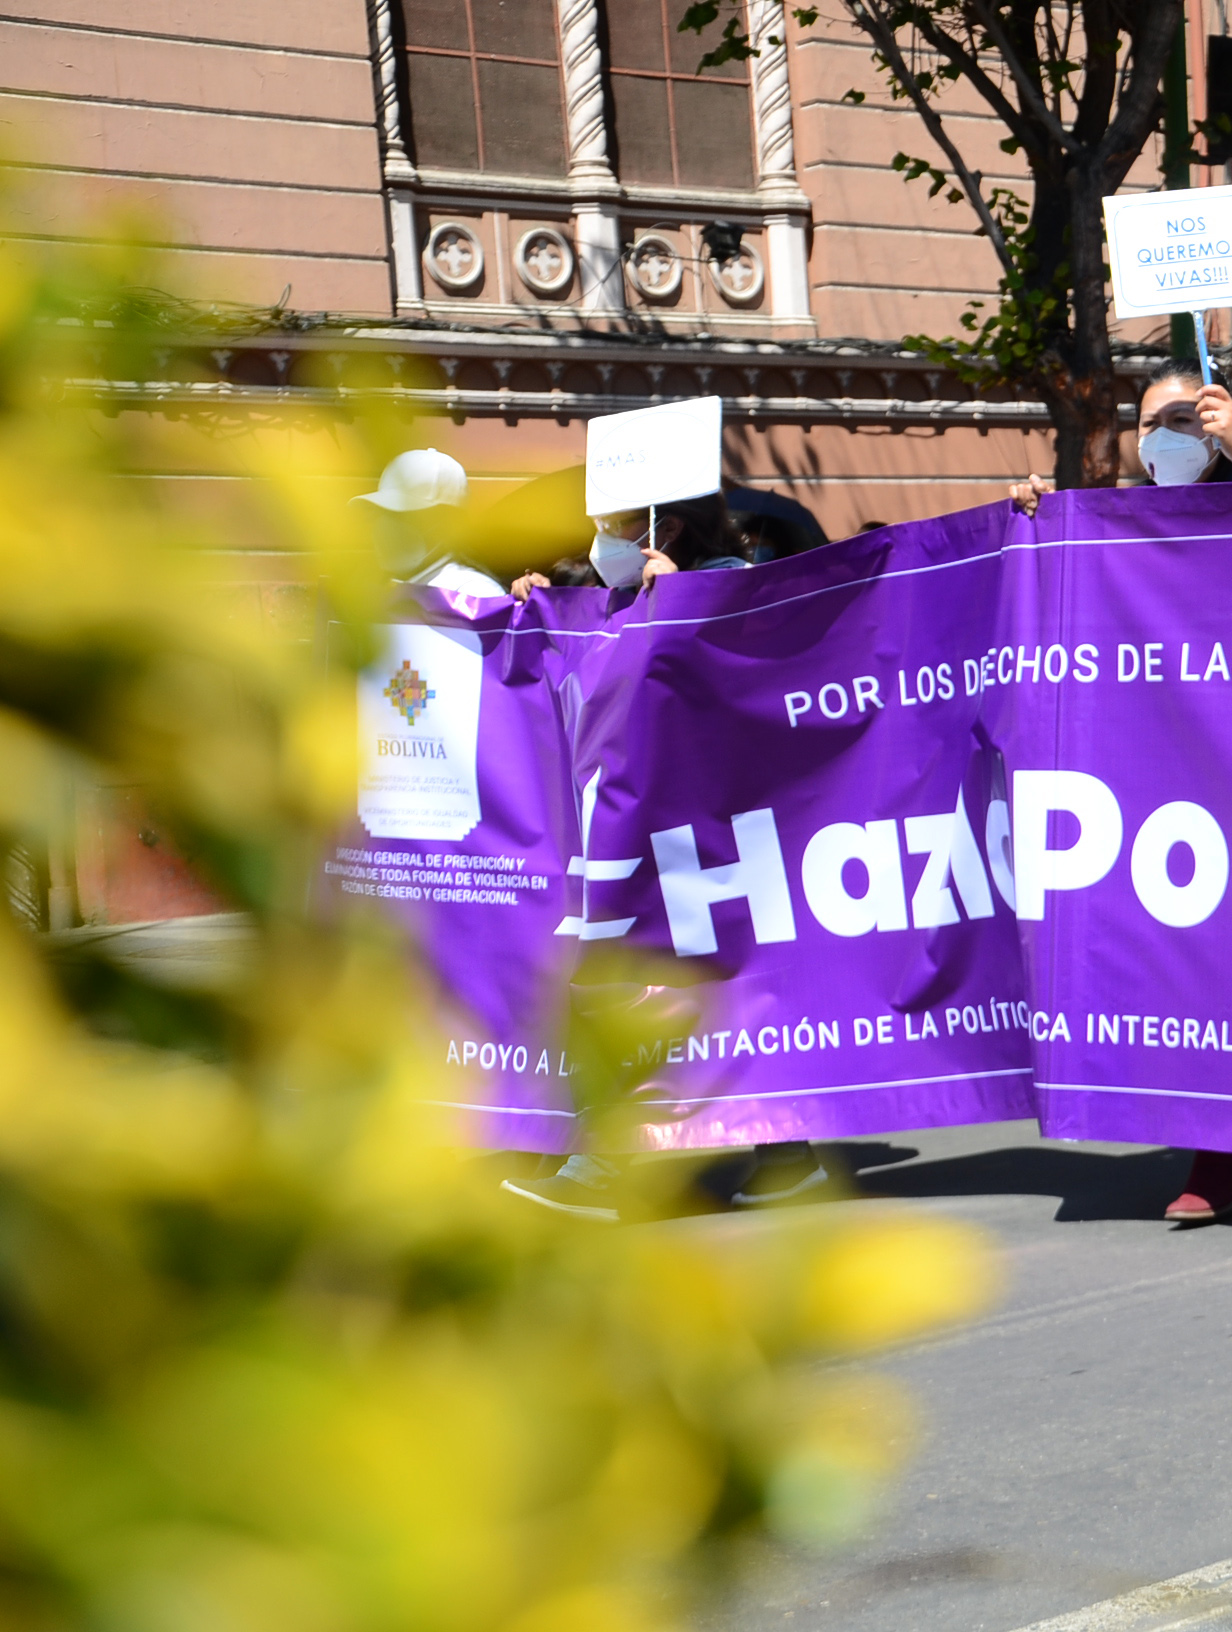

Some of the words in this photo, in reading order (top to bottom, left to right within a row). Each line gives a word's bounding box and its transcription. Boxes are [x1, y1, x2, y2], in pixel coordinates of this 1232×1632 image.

[1166, 216, 1206, 234] NOS
[1155, 266, 1229, 287] VIVAS!!!
[783, 674, 885, 727] POR
[899, 656, 956, 707] LOS
[1117, 642, 1164, 683] DE
[376, 738, 447, 760] BOLIVIA
[374, 851, 424, 867] GENERAL
[425, 854, 442, 868] DE
[443, 854, 515, 871] PREVENCIÓN
[516, 858, 526, 871] Y
[366, 867, 379, 880] DE
[380, 868, 412, 882] TODA
[412, 870, 453, 885] FORMA
[455, 872, 472, 886] DE
[473, 873, 530, 889] VIOLENCIA
[531, 875, 549, 890] EN
[365, 884, 377, 896] DE
[377, 883, 422, 900] GÉNERO
[422, 887, 432, 900] Y
[432, 888, 519, 906] GENERACIONAL
[446, 1039, 528, 1073] APOYO
[535, 1048, 549, 1076] A
[854, 1016, 894, 1047] DE
[905, 1010, 939, 1040] LA
